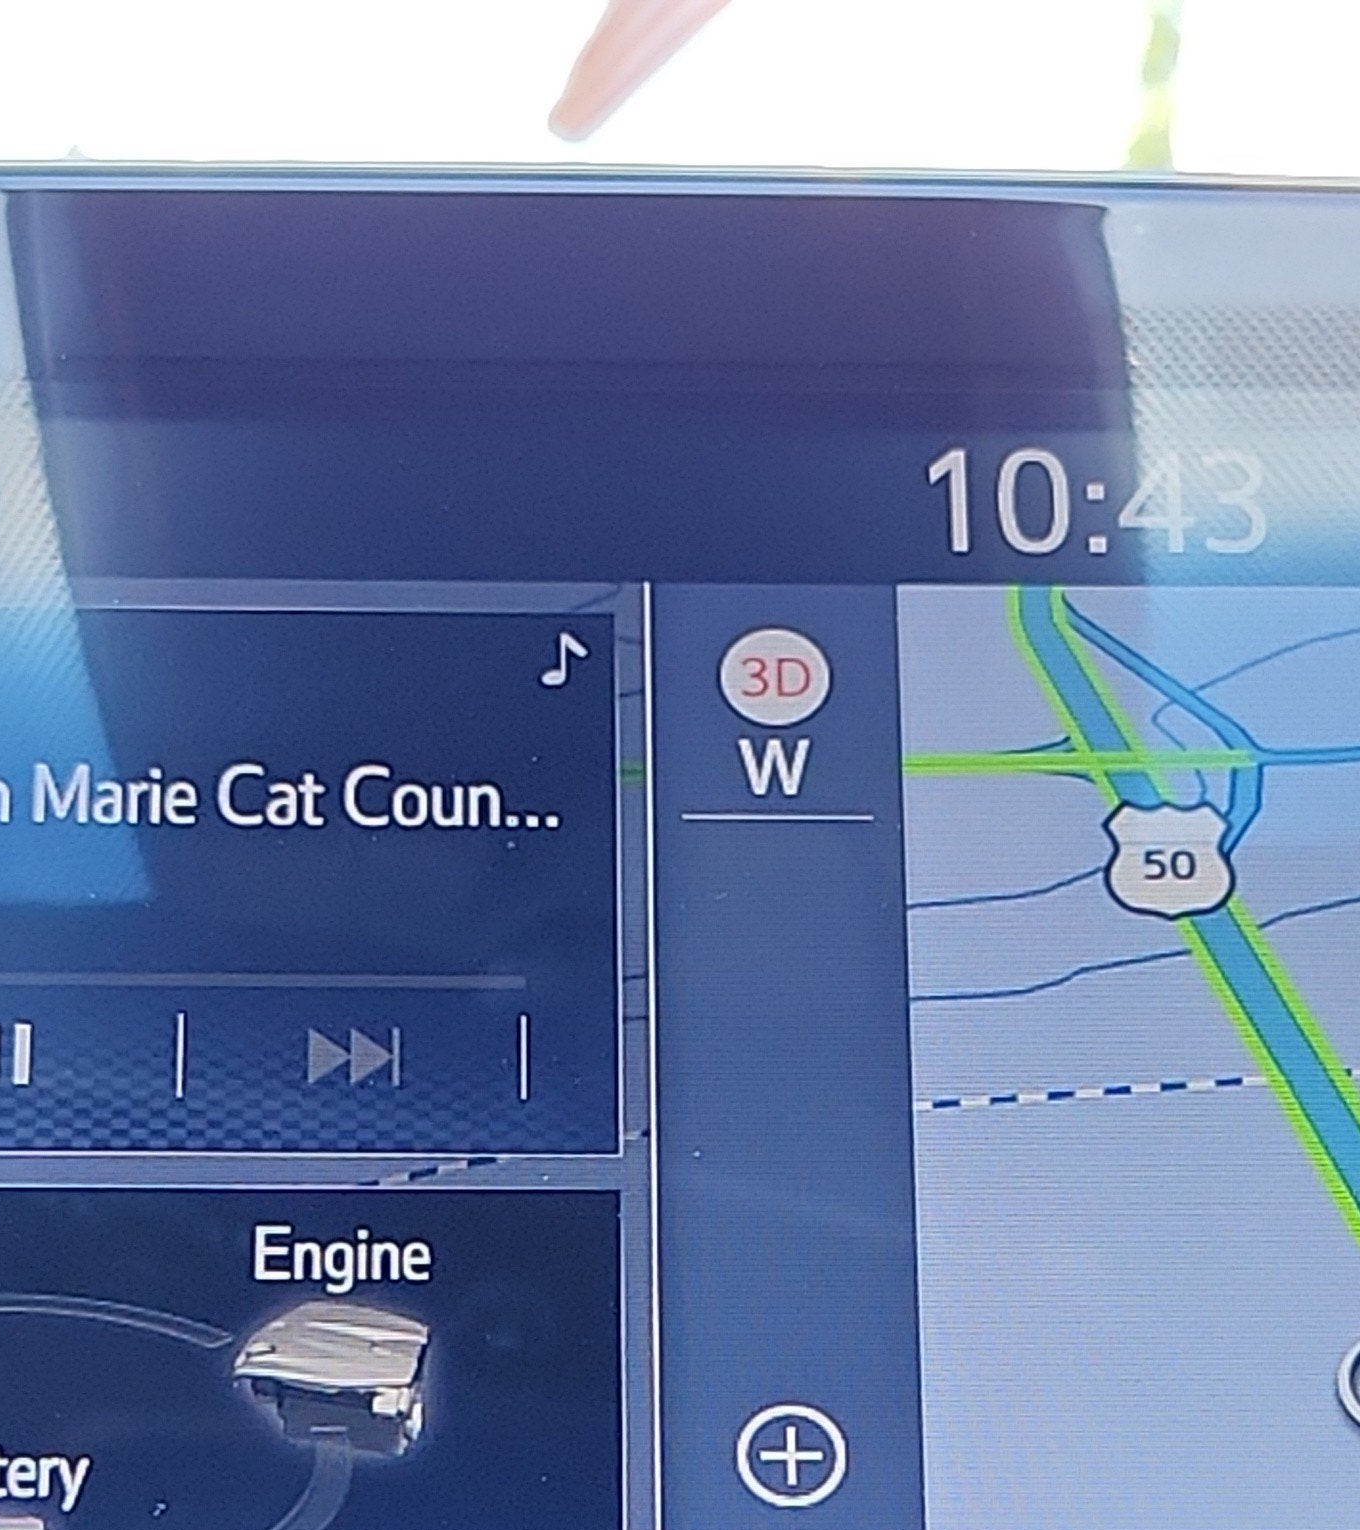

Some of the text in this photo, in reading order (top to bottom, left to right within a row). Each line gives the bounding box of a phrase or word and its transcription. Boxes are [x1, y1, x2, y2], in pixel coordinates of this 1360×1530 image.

[926, 447, 1269, 554] 10:43
[740, 657, 812, 698] 3D
[33, 762, 197, 828] Marie
[217, 764, 325, 828] Cat
[344, 764, 561, 829] Coun...
[739, 738, 811, 796] W
[1144, 850, 1196, 881] 50
[253, 1225, 432, 1294] Engine
